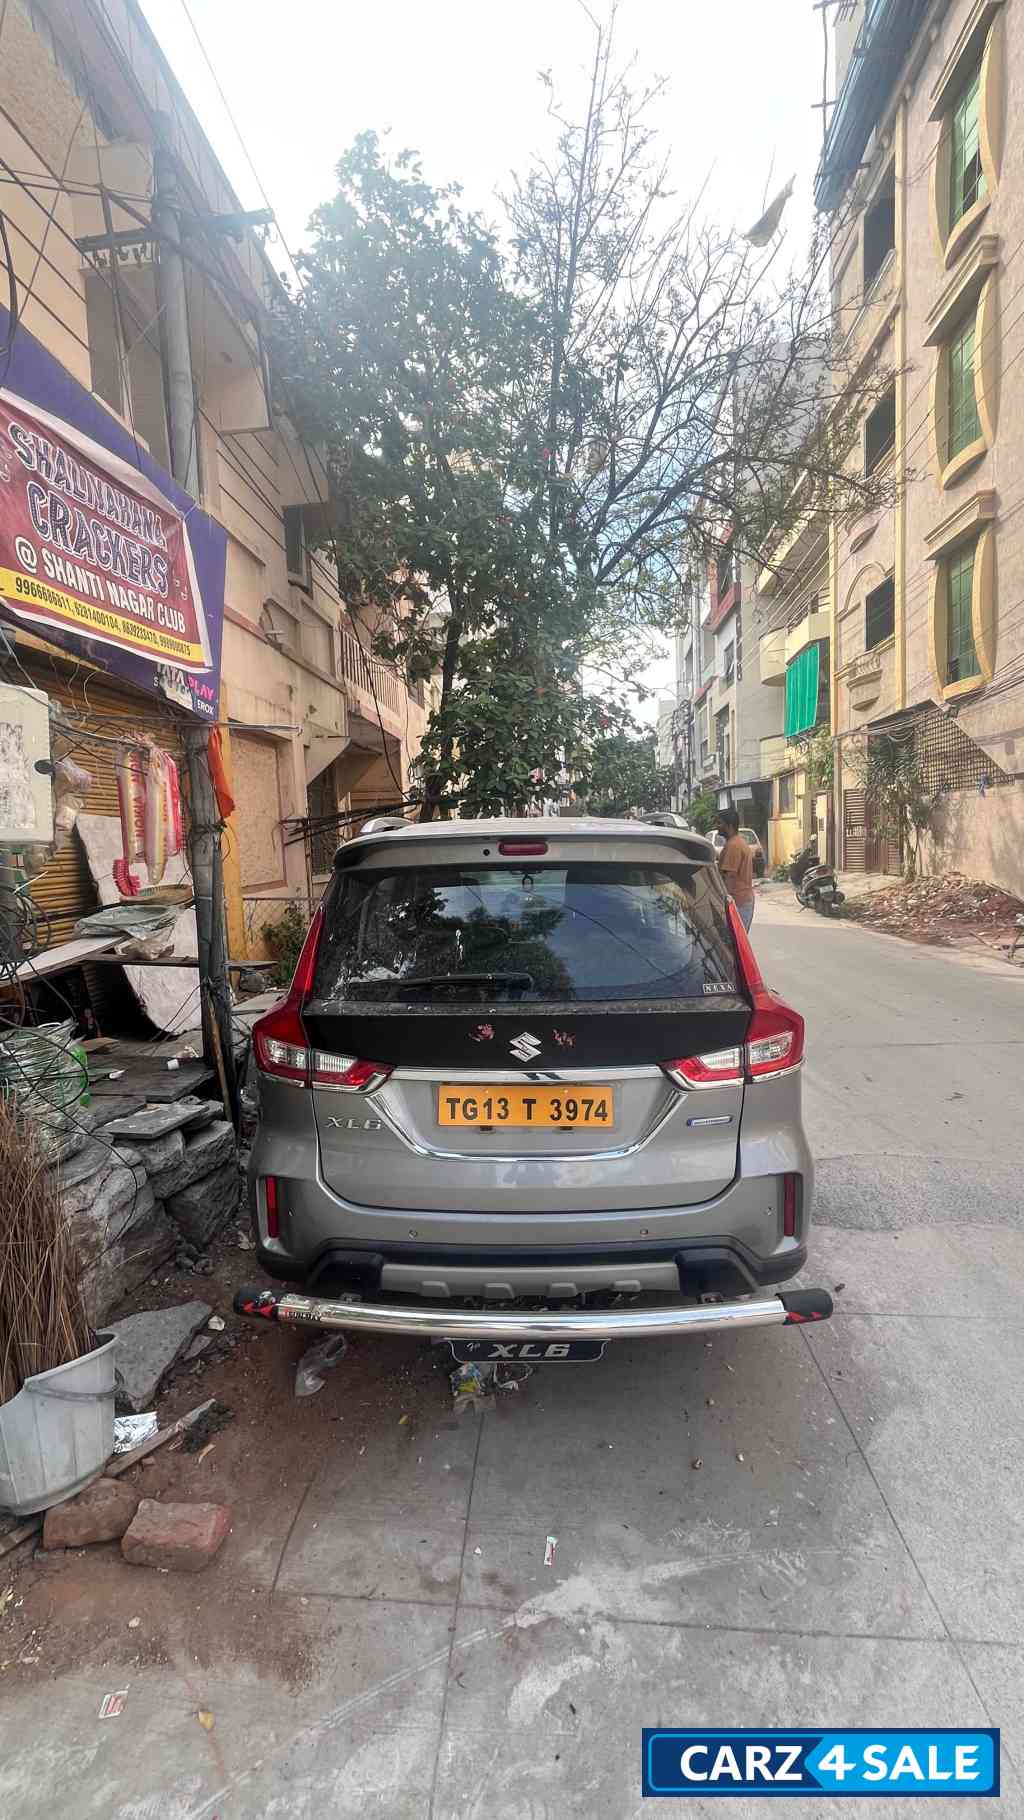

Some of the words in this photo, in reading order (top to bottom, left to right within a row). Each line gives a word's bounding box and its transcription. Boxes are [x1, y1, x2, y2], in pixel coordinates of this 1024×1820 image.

[27, 480, 168, 599] CRACKERS
[15, 536, 38, 574] @
[41, 548, 105, 601] SHANTI
[106, 580, 156, 622] NAGAR
[157, 601, 187, 634] CLUB
[446, 1097, 510, 1121] TG13
[522, 1098, 537, 1121] T
[549, 1098, 608, 1122] 3974
[324, 1115, 382, 1130] XL6
[487, 1343, 571, 1358] XL6
